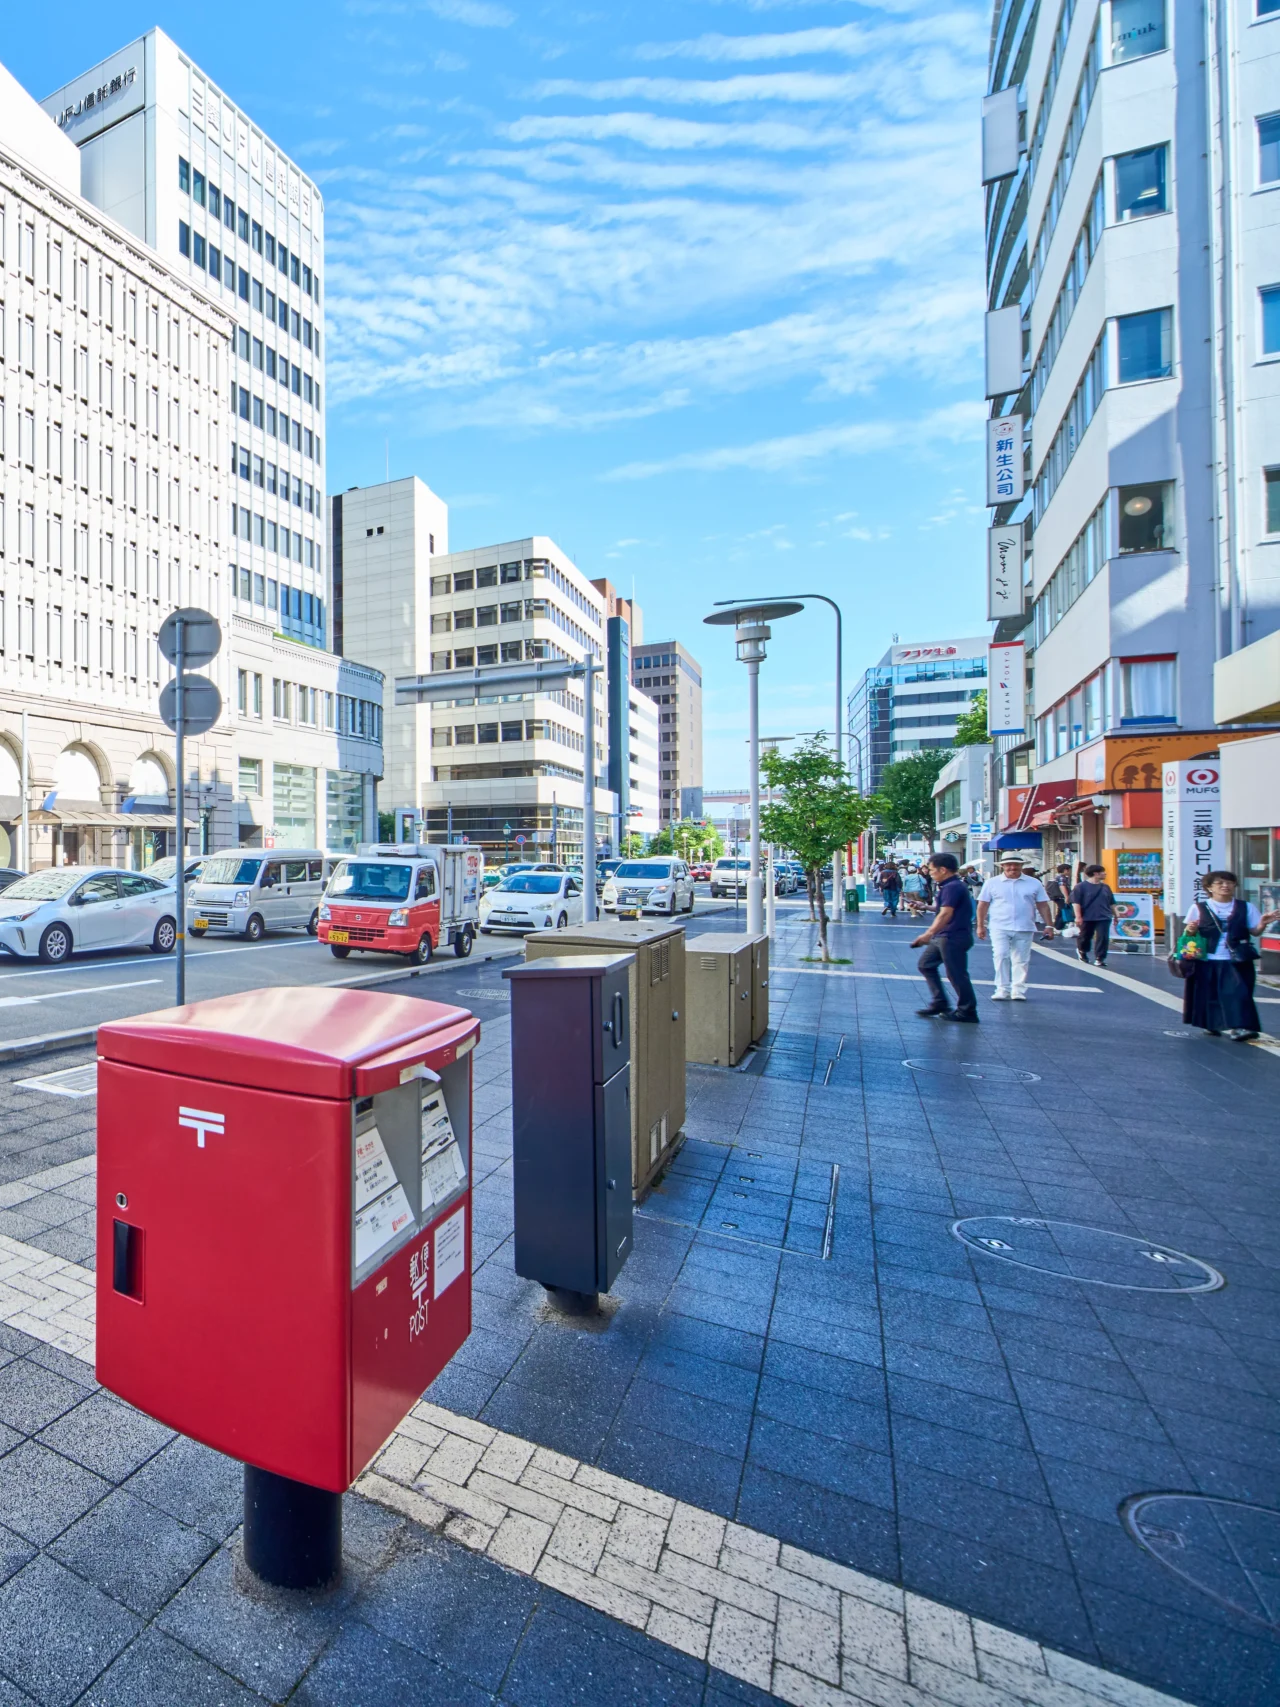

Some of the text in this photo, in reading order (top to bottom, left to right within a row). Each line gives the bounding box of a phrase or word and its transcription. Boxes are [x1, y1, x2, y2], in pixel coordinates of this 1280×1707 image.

[995, 437, 1014, 496] 新生公司
[901, 646, 957, 658] フコク生命
[409, 1241, 430, 1287] 郵便
[409, 1299, 430, 1343] POST
